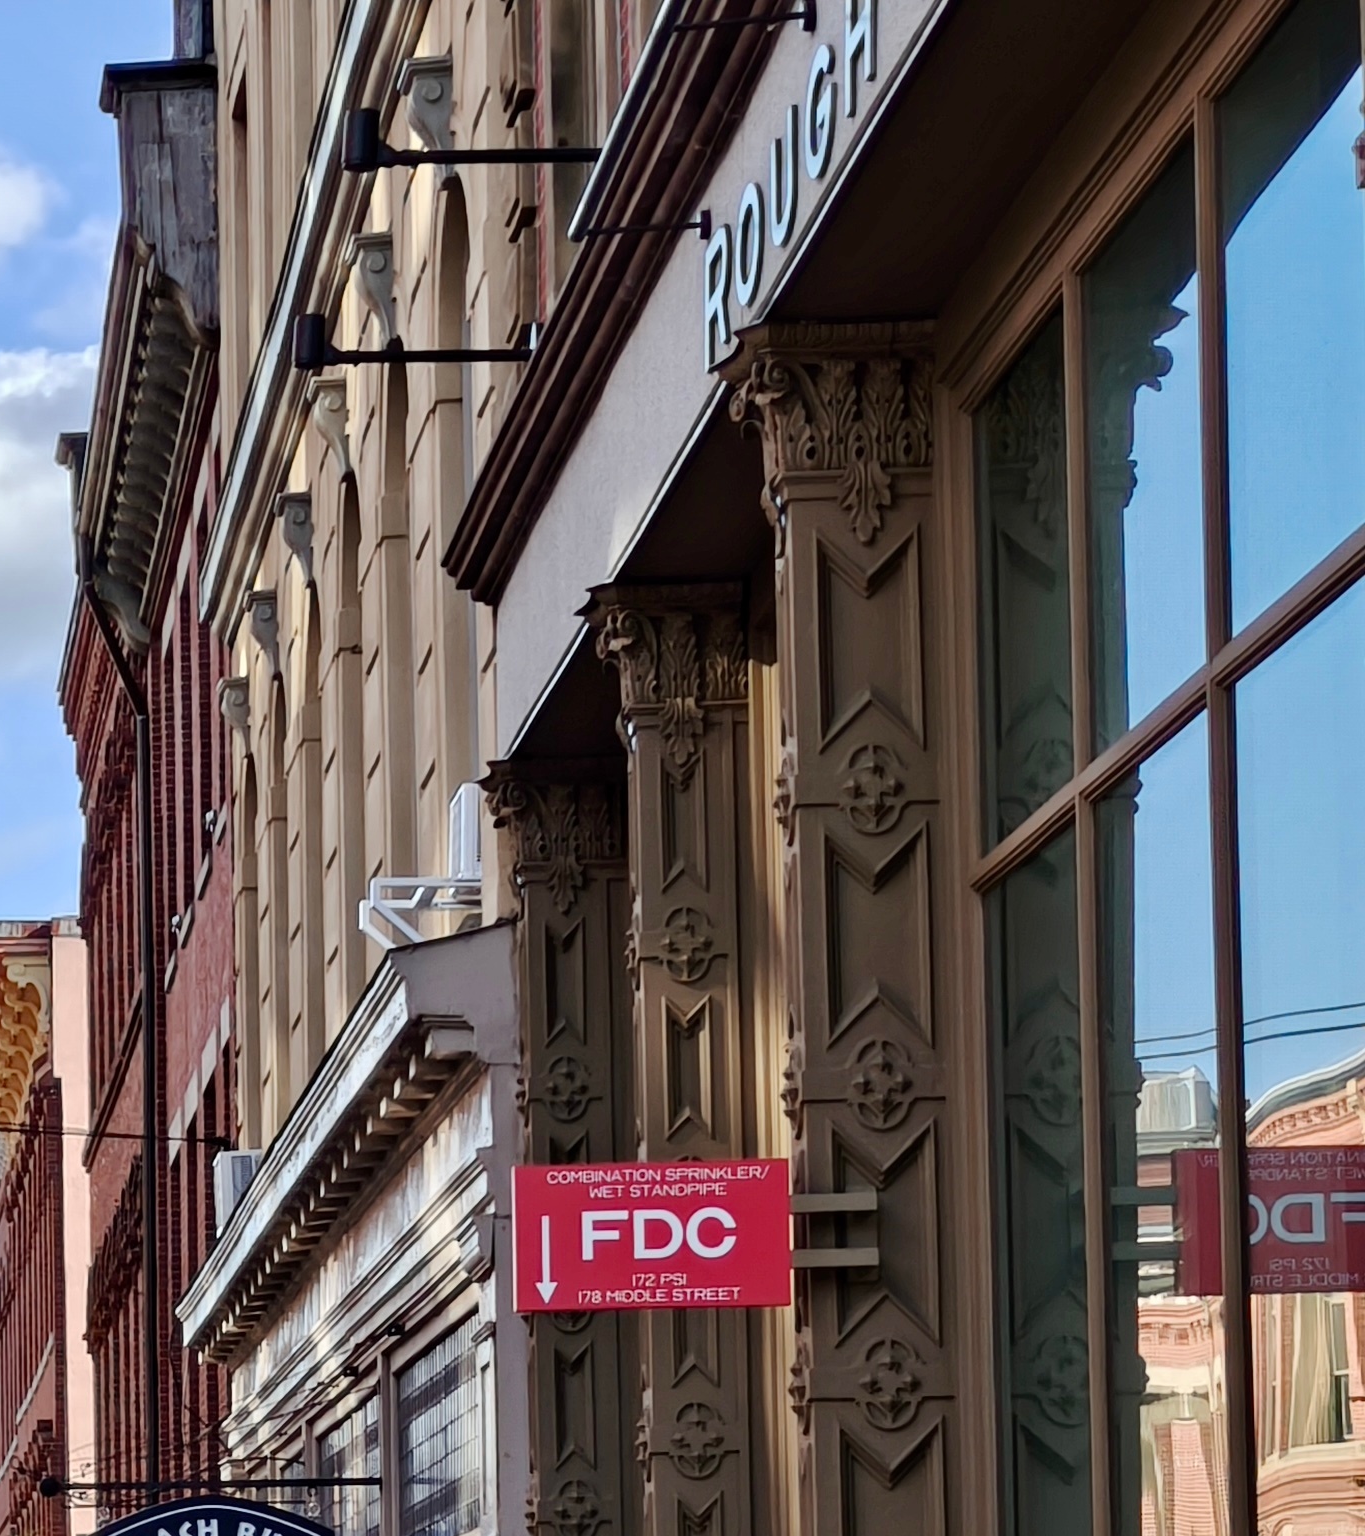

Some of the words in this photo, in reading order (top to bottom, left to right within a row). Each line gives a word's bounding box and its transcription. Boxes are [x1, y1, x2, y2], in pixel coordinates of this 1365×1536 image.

[703, 0, 878, 374] ROUGH
[546, 1168, 661, 1185] COMBINATION
[665, 1164, 771, 1181] SPRINKLER/
[589, 1185, 624, 1198] WET
[629, 1182, 727, 1198] STANDPIPE
[581, 1206, 737, 1262] FDC
[632, 1273, 655, 1288] 172
[660, 1272, 687, 1286] PSI
[578, 1290, 602, 1304] 178
[606, 1288, 669, 1303] MIDDLE
[672, 1287, 741, 1301] STREET
